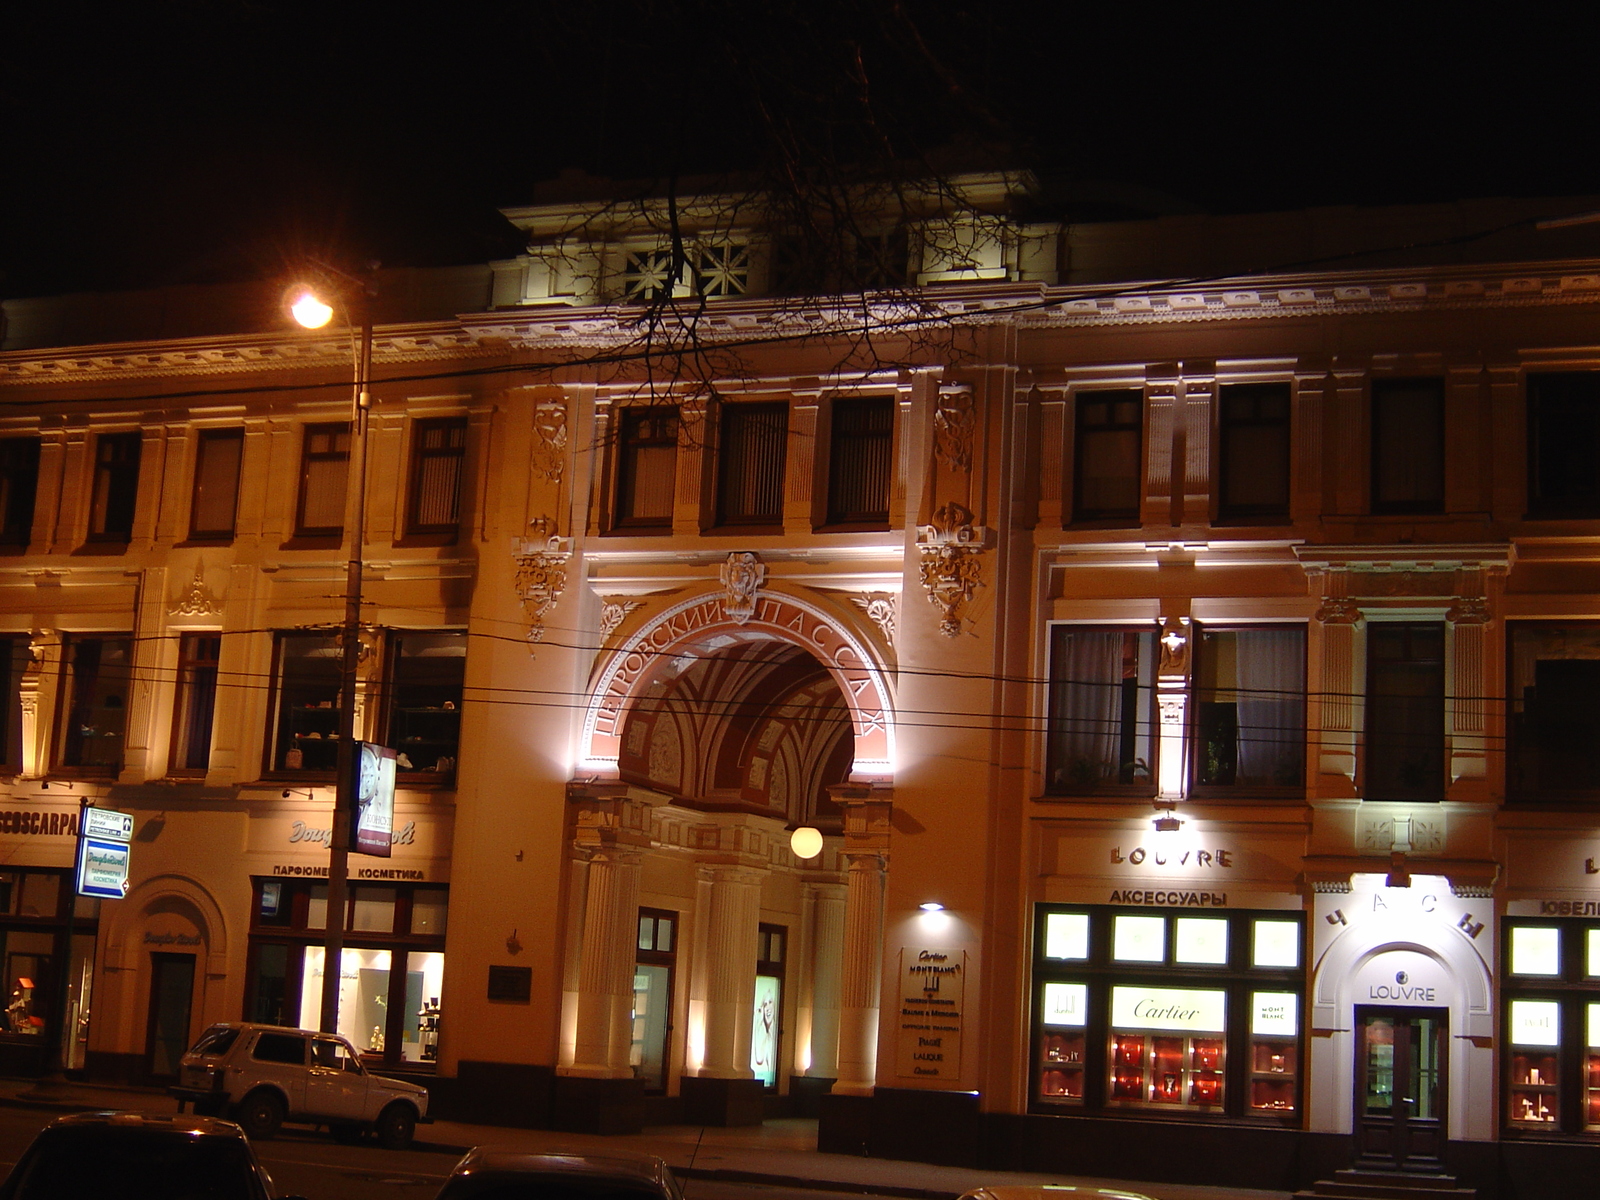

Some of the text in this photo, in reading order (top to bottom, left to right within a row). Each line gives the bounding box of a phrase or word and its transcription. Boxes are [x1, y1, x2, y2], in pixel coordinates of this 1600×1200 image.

[593, 600, 885, 737] ПЕТРОВСКИЙ ПАССАЖ
[0, 811, 77, 836] COSCARPA
[1110, 846, 1233, 868] LOUVRE
[358, 868, 424, 880] КОСМЕТИКА
[1110, 890, 1228, 907] АКСЕССУАРЫ
[1369, 985, 1435, 1001] LOUVRE
[1133, 998, 1200, 1021] Cartier
